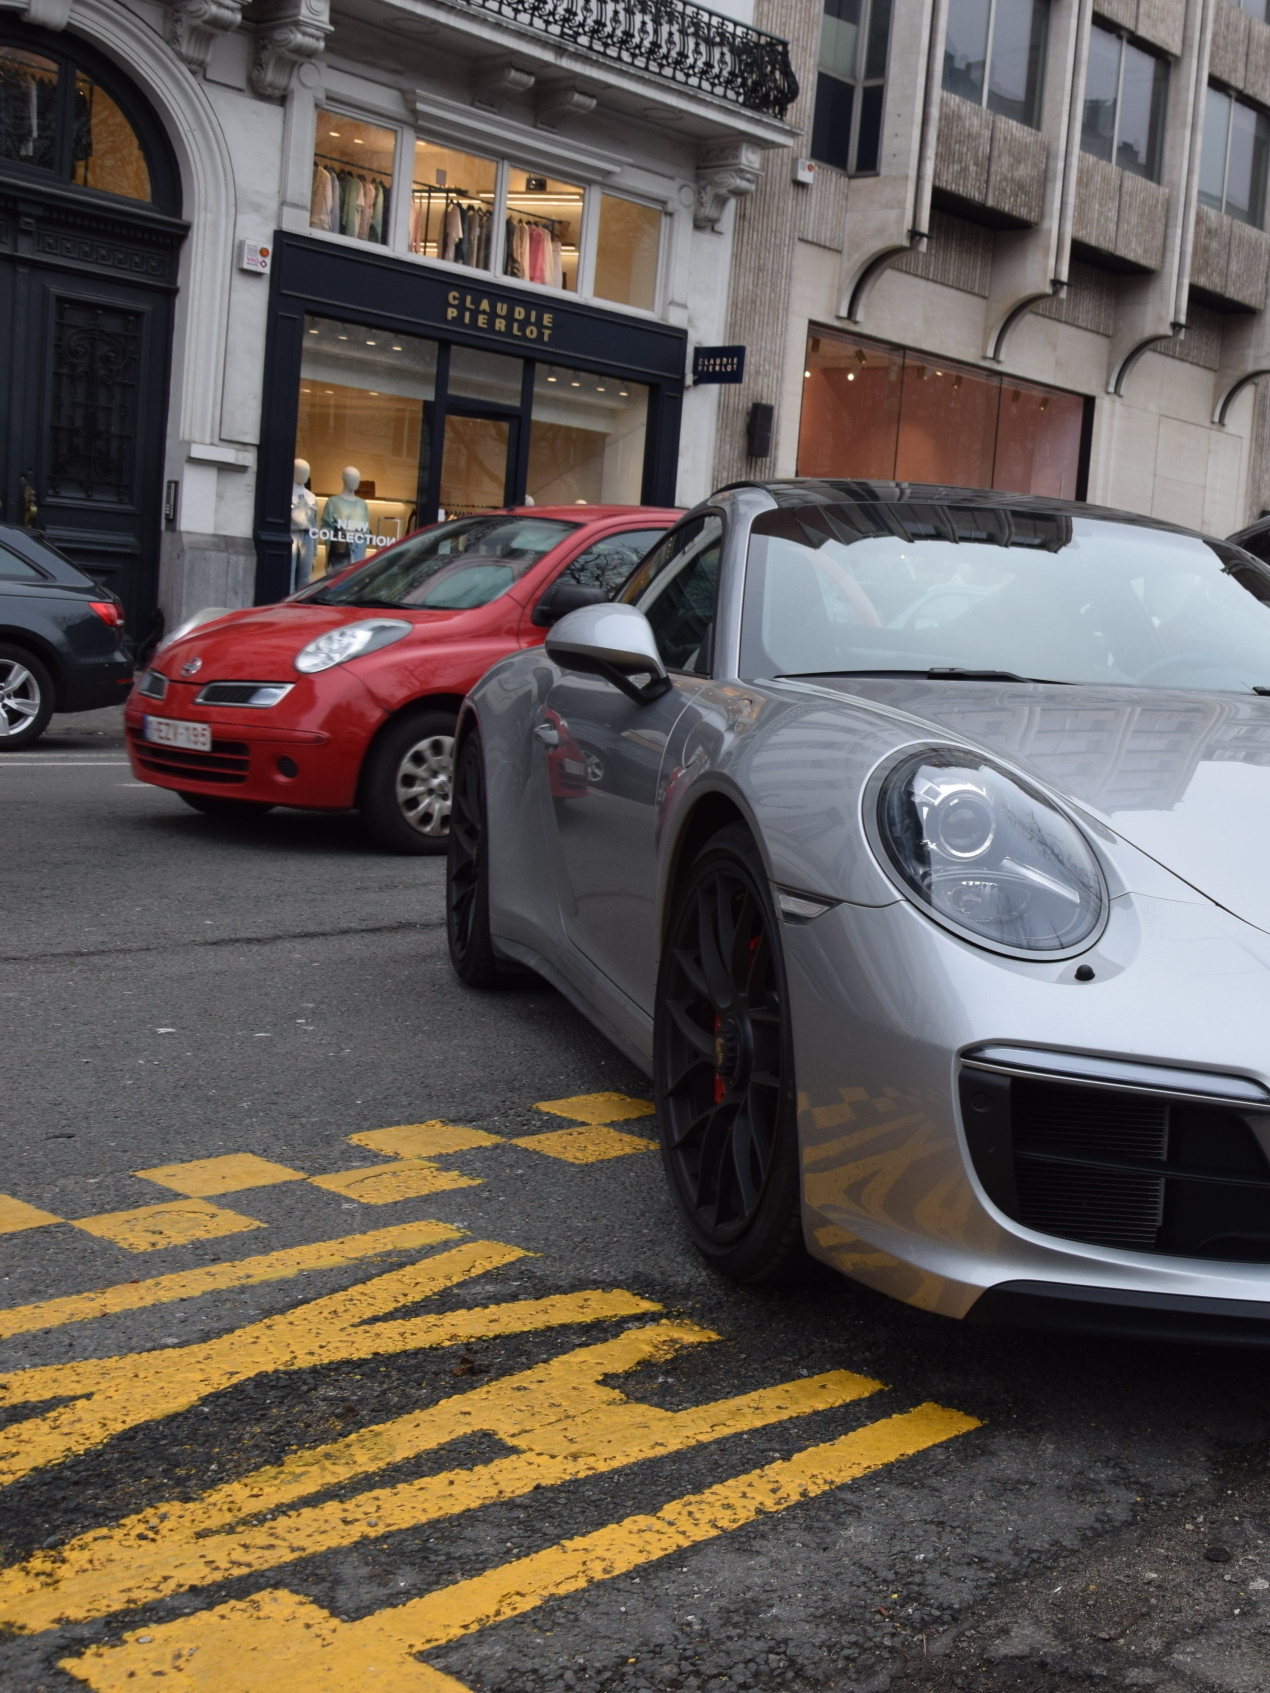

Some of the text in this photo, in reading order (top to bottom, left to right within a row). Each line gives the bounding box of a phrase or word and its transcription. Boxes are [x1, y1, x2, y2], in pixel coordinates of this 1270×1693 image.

[448, 291, 553, 327] CLAUDIE
[447, 307, 552, 342] PIERLOT
[698, 364, 737, 372] PIERLOT
[699, 357, 738, 365] CLAUDIE
[336, 519, 369, 532] NEW
[309, 529, 397, 546] COLLECTION
